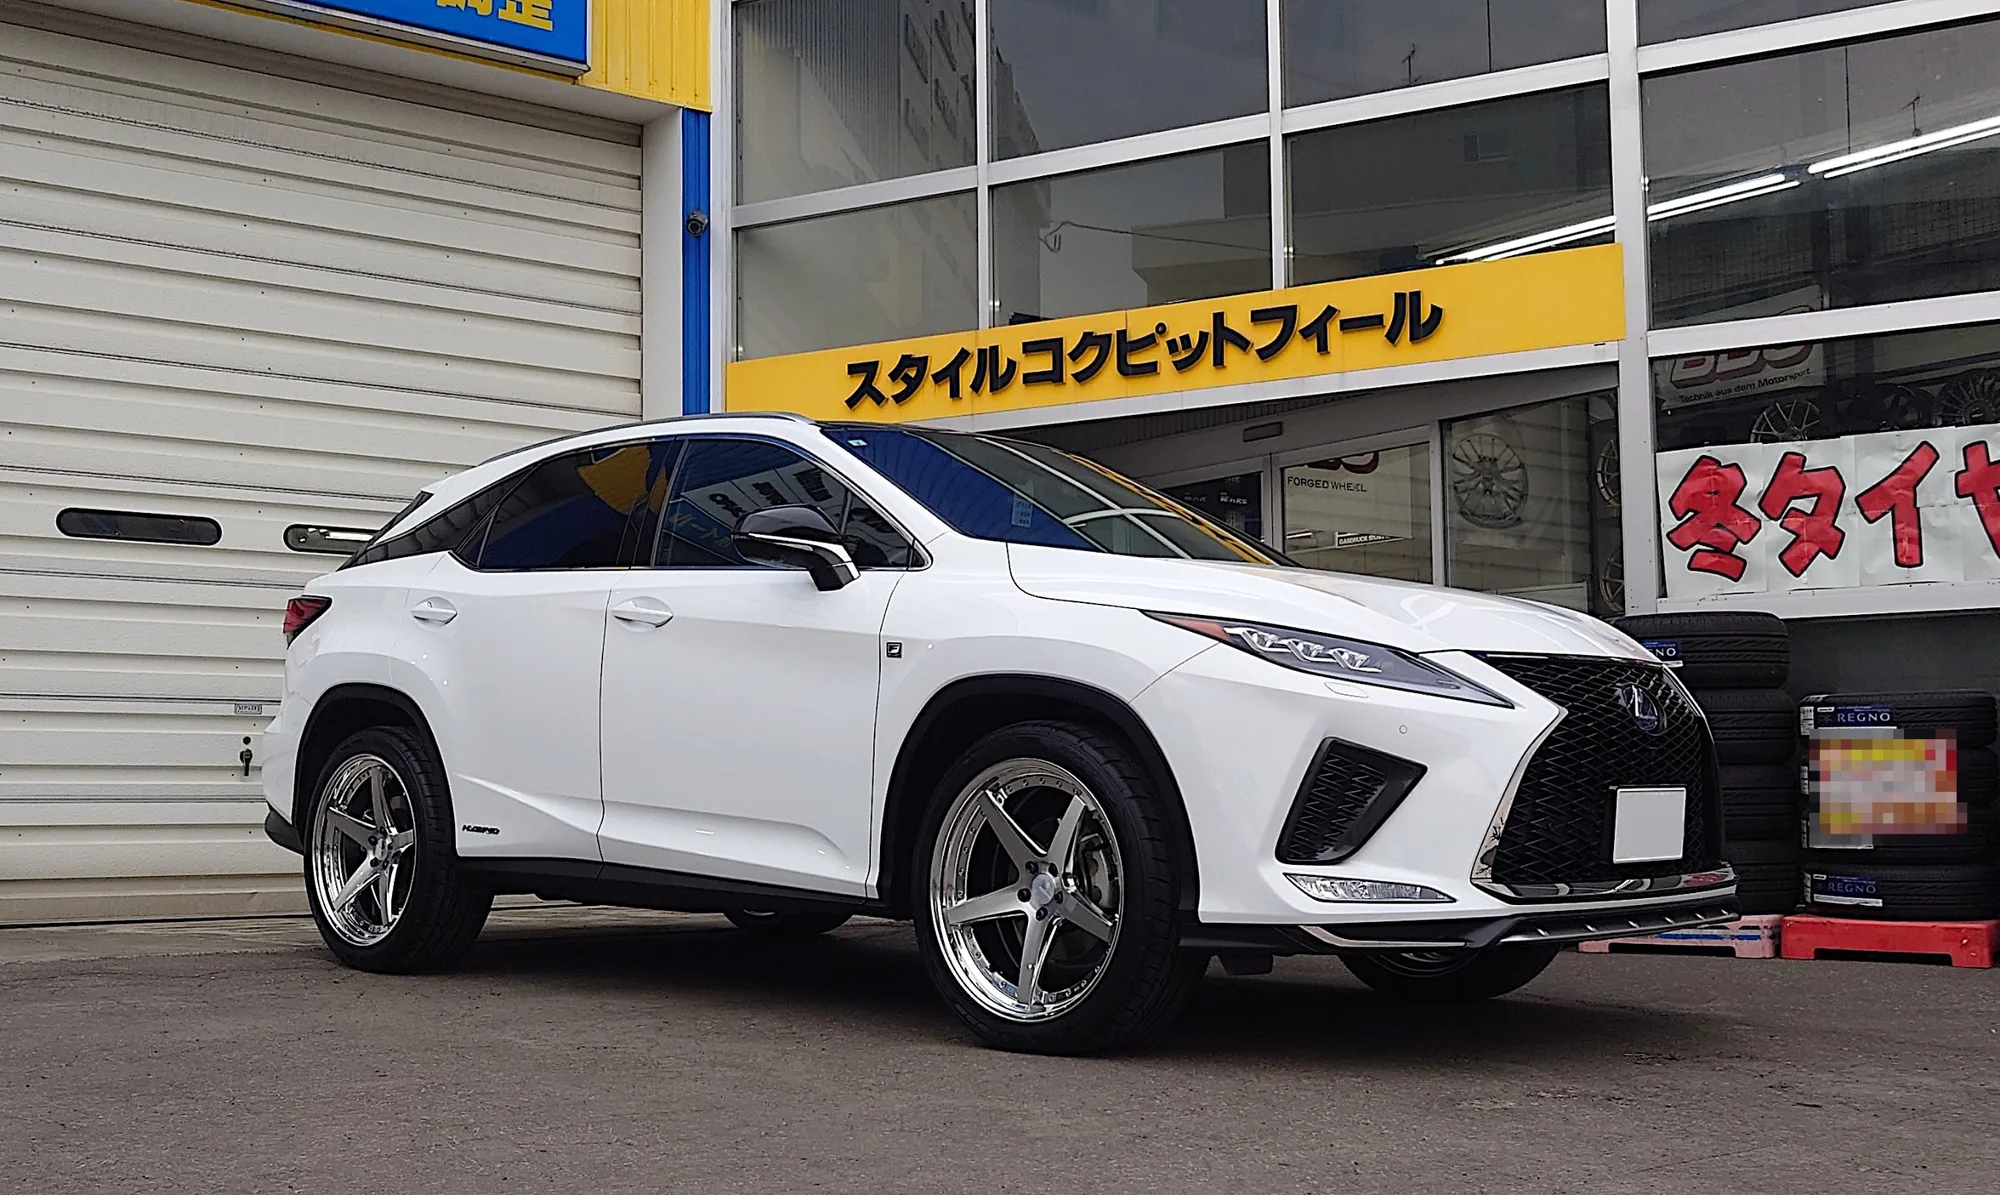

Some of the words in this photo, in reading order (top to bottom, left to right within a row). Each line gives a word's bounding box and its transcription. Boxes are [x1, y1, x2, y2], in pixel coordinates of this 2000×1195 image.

[845, 290, 1442, 408] スタイルコクピットフィール
[1679, 391, 1714, 403] Technik
[1715, 387, 1732, 397] aus
[1735, 382, 1756, 393] dem
[1758, 368, 1811, 388] Motorsport
[1287, 476, 1330, 490] FORGED
[1331, 481, 1368, 492] WHEEL
[1837, 712, 1891, 722] REGNO
[1828, 881, 1877, 894] REGNO
